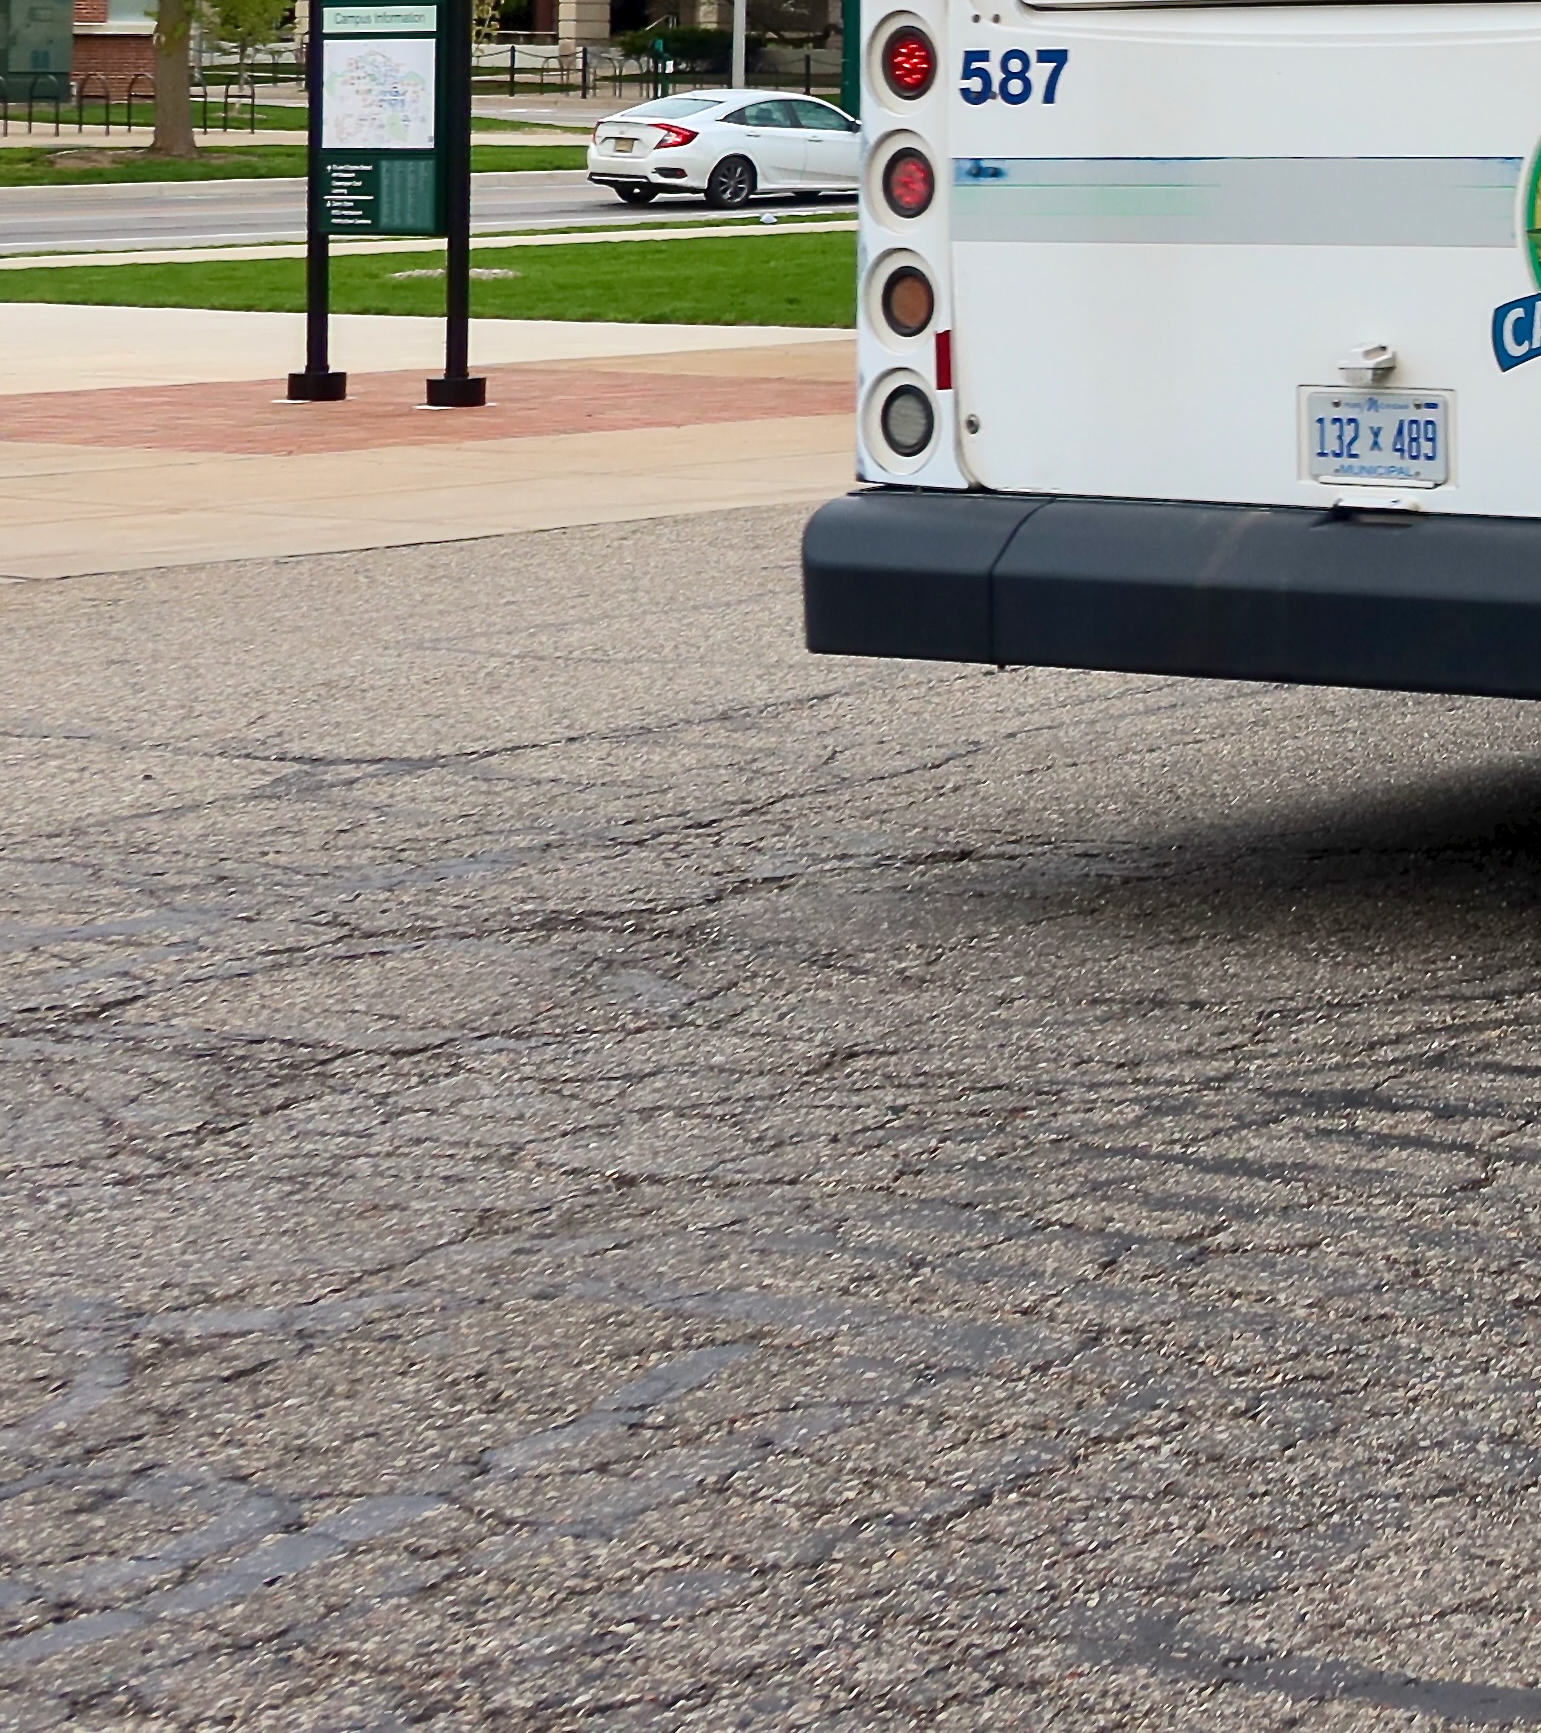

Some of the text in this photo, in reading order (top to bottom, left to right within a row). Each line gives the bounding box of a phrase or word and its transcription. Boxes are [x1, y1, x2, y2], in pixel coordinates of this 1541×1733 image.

[335, 11, 426, 26] Campus Information
[958, 48, 1069, 106] 587
[1315, 416, 1361, 459] 132
[1392, 419, 1437, 461] 489
